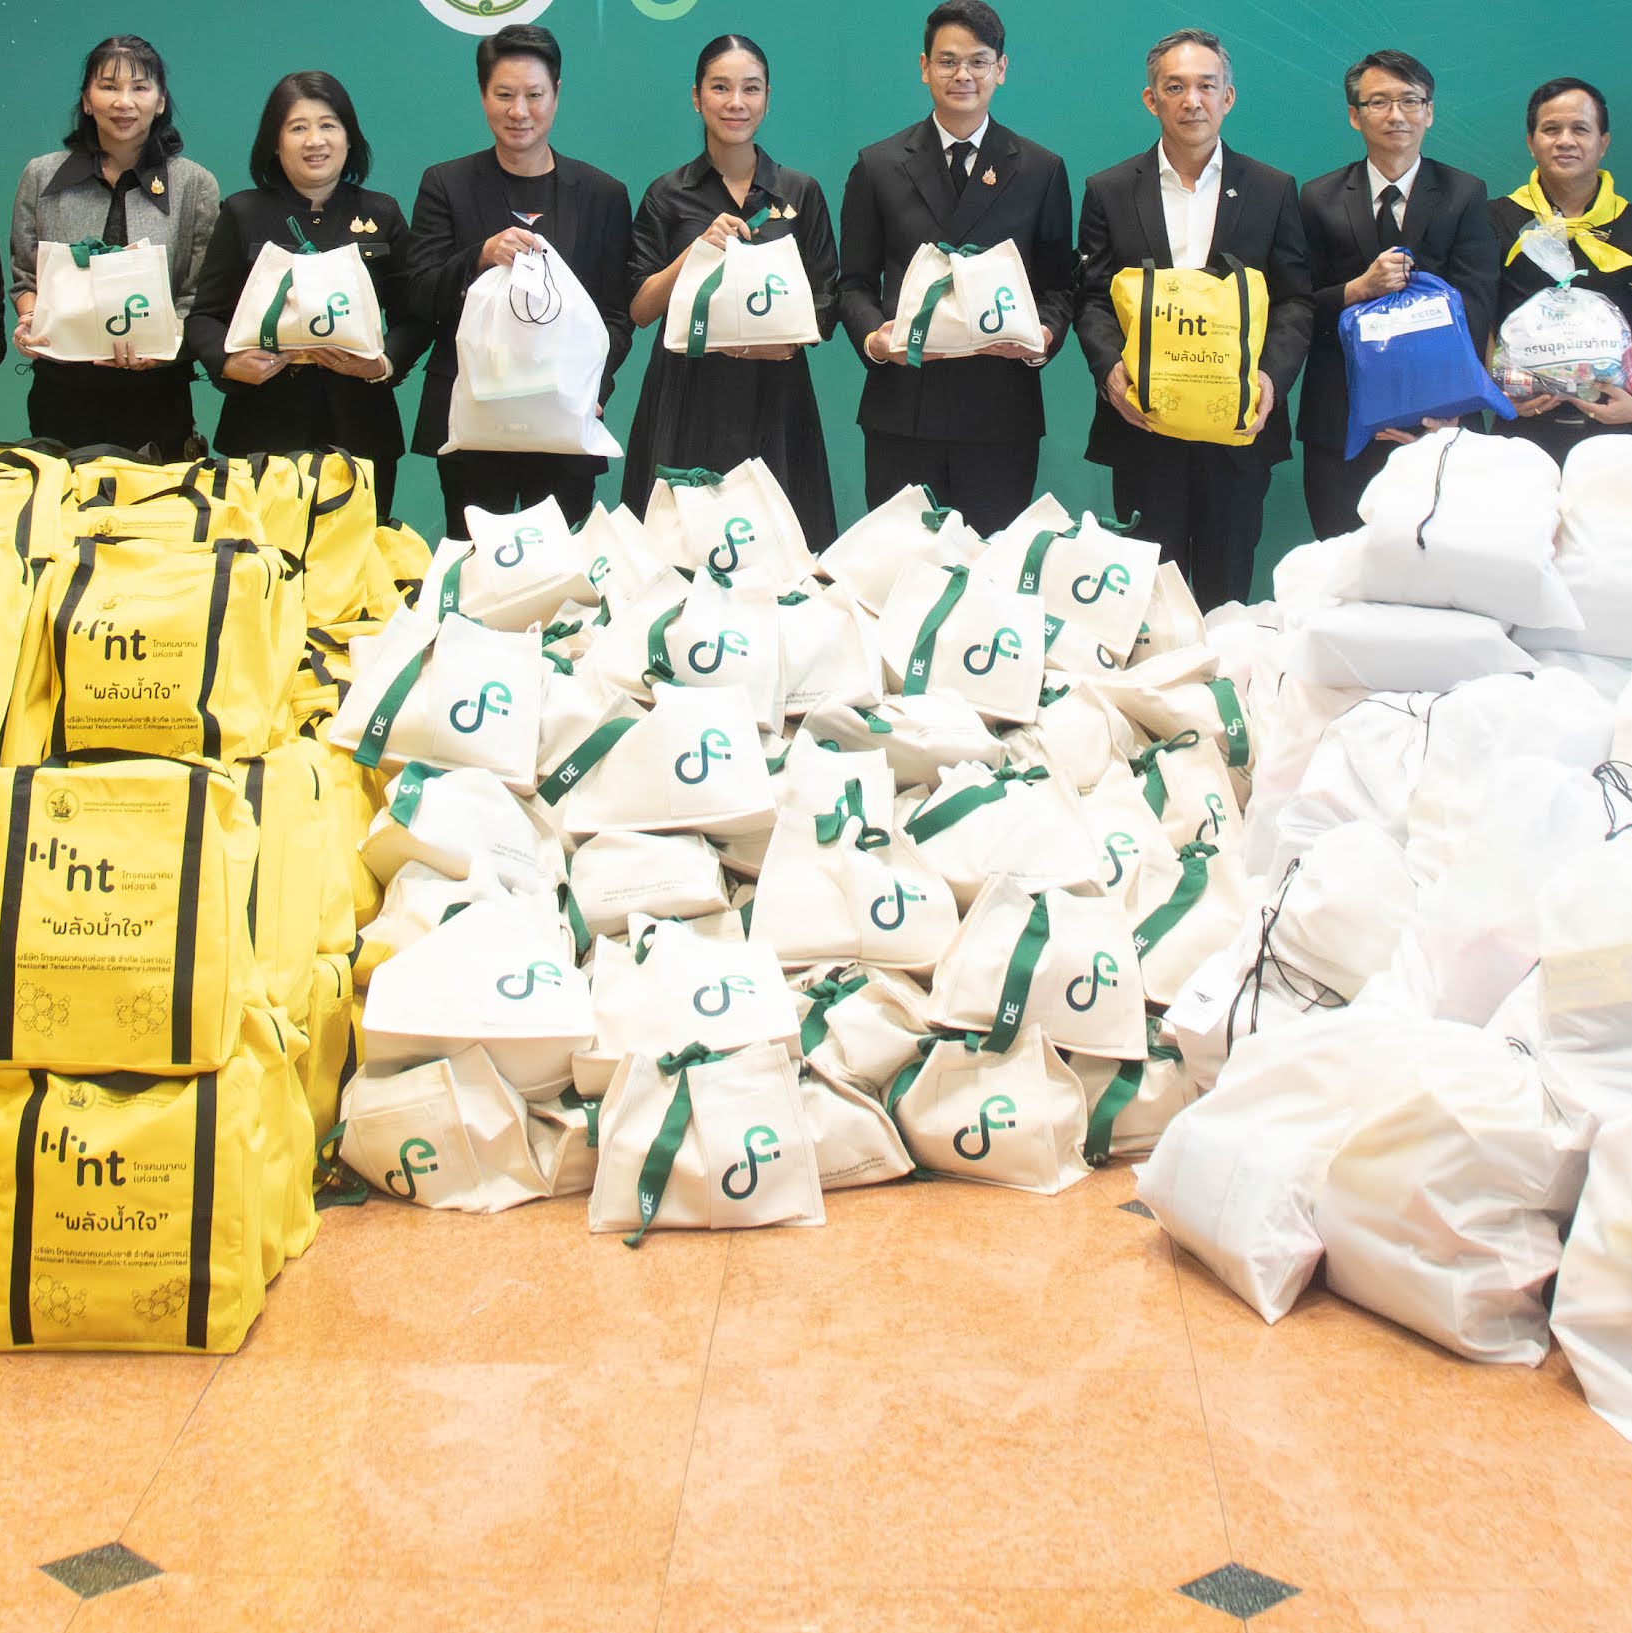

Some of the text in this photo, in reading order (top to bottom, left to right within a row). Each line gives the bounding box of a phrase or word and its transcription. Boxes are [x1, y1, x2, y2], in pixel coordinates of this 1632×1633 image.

[693, 320, 705, 336] DE
[1178, 315, 1207, 336] nt
[911, 329, 923, 344] DE
[1023, 572, 1035, 590] DE
[443, 590, 454, 609] DE
[105, 629, 147, 660] nt
[912, 658, 925, 677] DE
[371, 713, 389, 738] DE
[559, 764, 580, 785] DE
[67, 859, 115, 892] nt
[1002, 1000, 1020, 1026] DE
[77, 1150, 126, 1186] nt
[642, 1192, 654, 1216] DE
